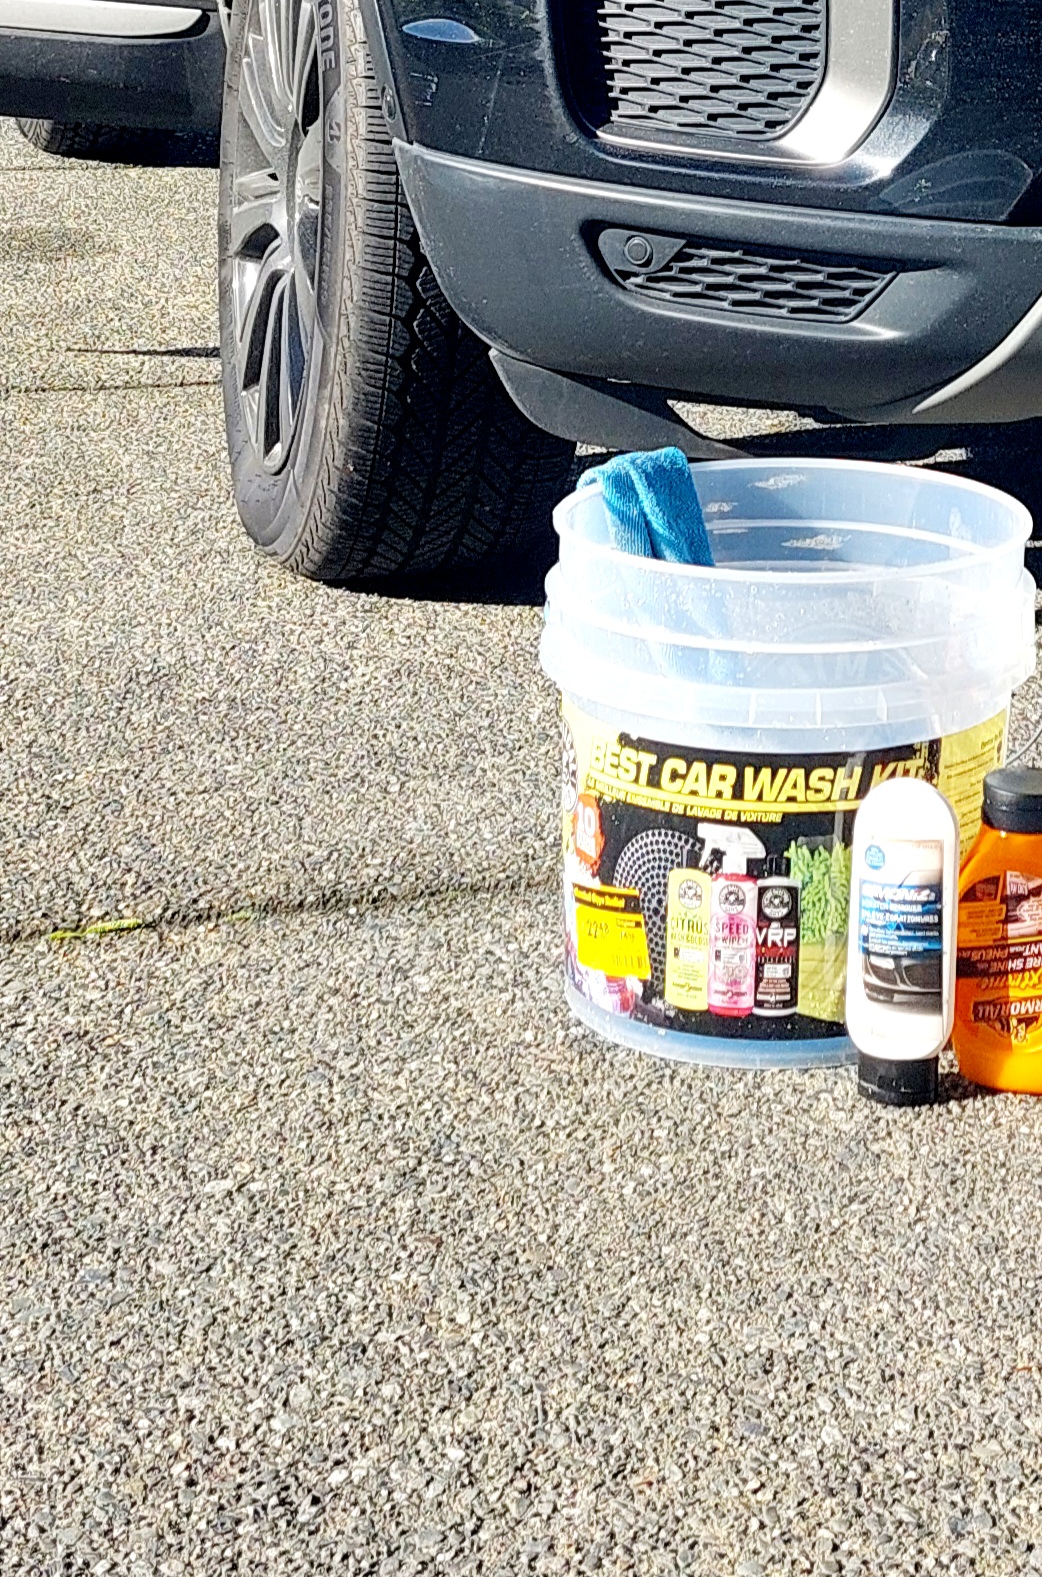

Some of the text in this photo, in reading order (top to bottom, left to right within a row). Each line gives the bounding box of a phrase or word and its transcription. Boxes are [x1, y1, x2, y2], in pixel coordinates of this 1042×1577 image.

[590, 736, 658, 787] BEST
[660, 758, 737, 800] CAR
[744, 766, 863, 803] WASH
[740, 811, 784, 823] VOITURE
[756, 926, 797, 948] VRP
[989, 958, 1025, 972] SHINE
